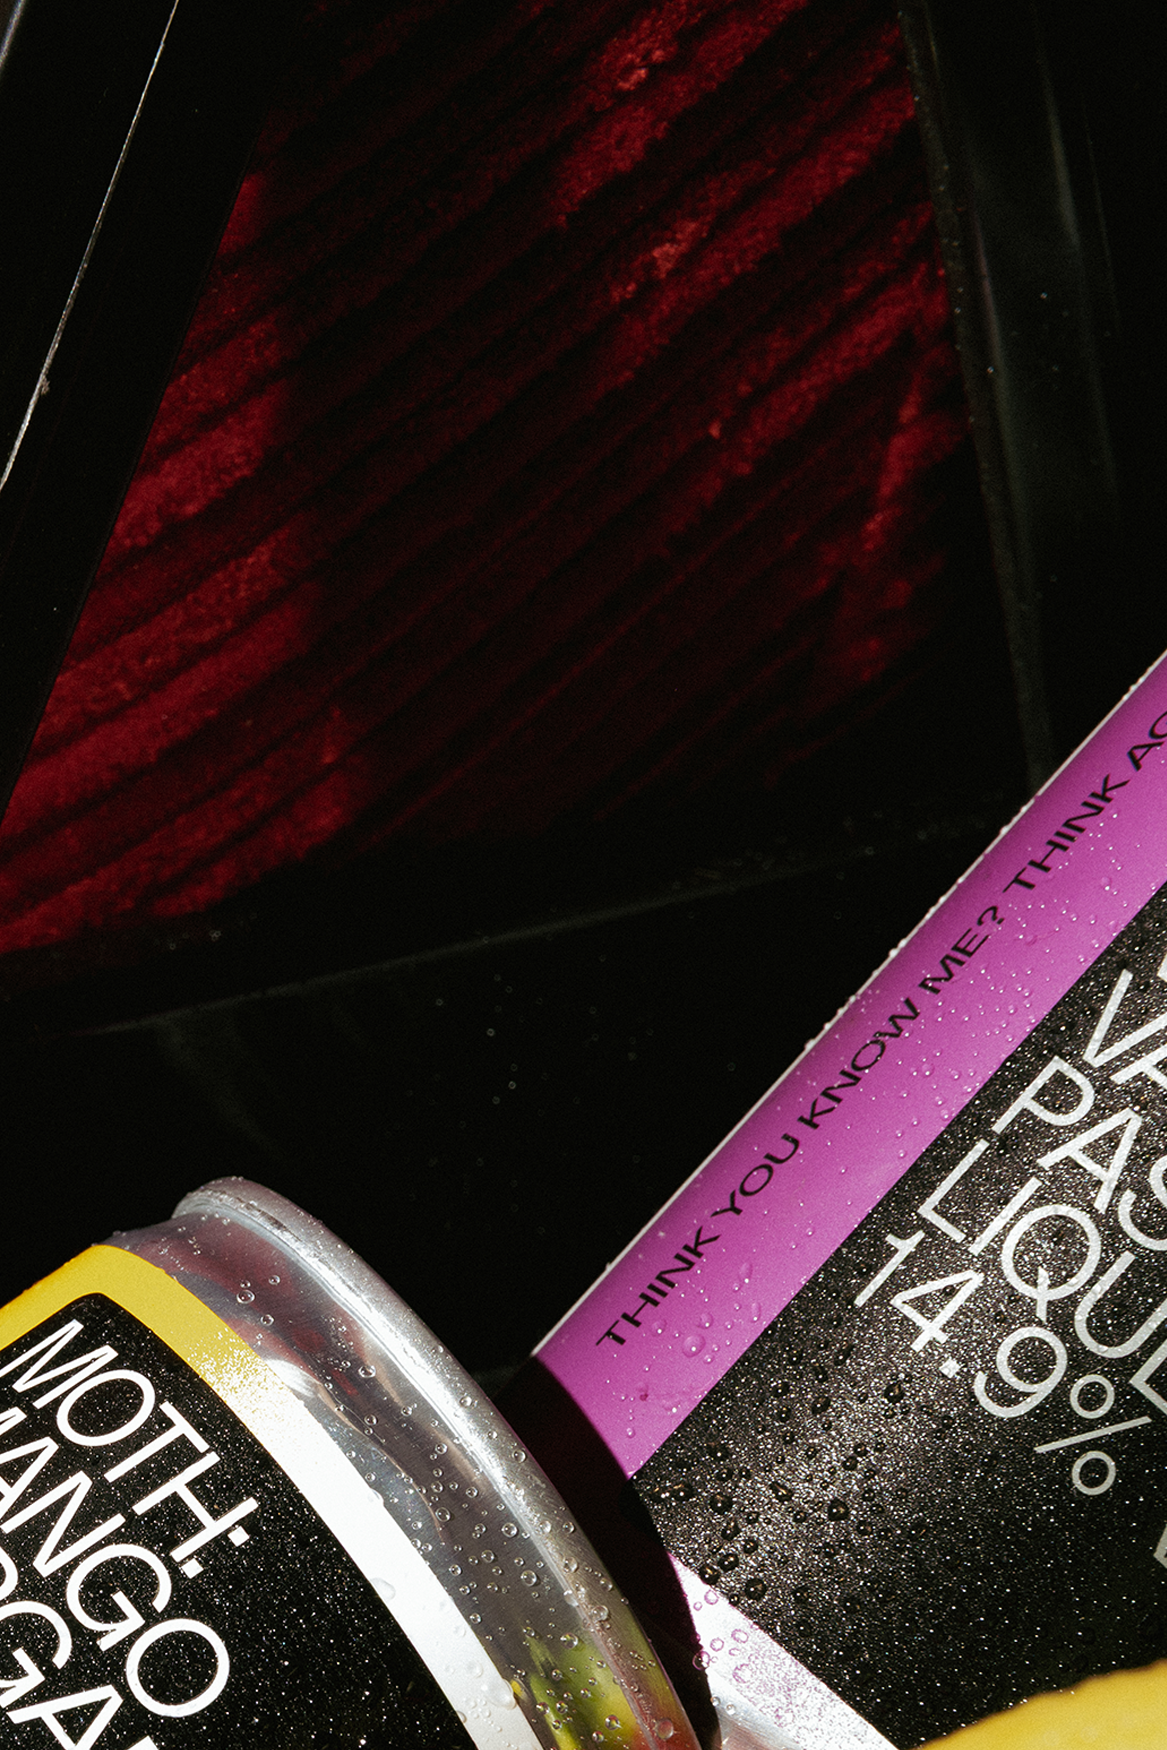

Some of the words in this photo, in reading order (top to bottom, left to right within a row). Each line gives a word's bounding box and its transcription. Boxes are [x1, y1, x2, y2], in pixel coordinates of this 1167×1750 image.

[596, 1228, 720, 1350] THINK
[712, 1133, 800, 1220] YOU
[798, 998, 921, 1131] KNOW
[919, 904, 1006, 994] ME?
[1002, 774, 1130, 888] THINK
[854, 1230, 1153, 1496] 14.9%
